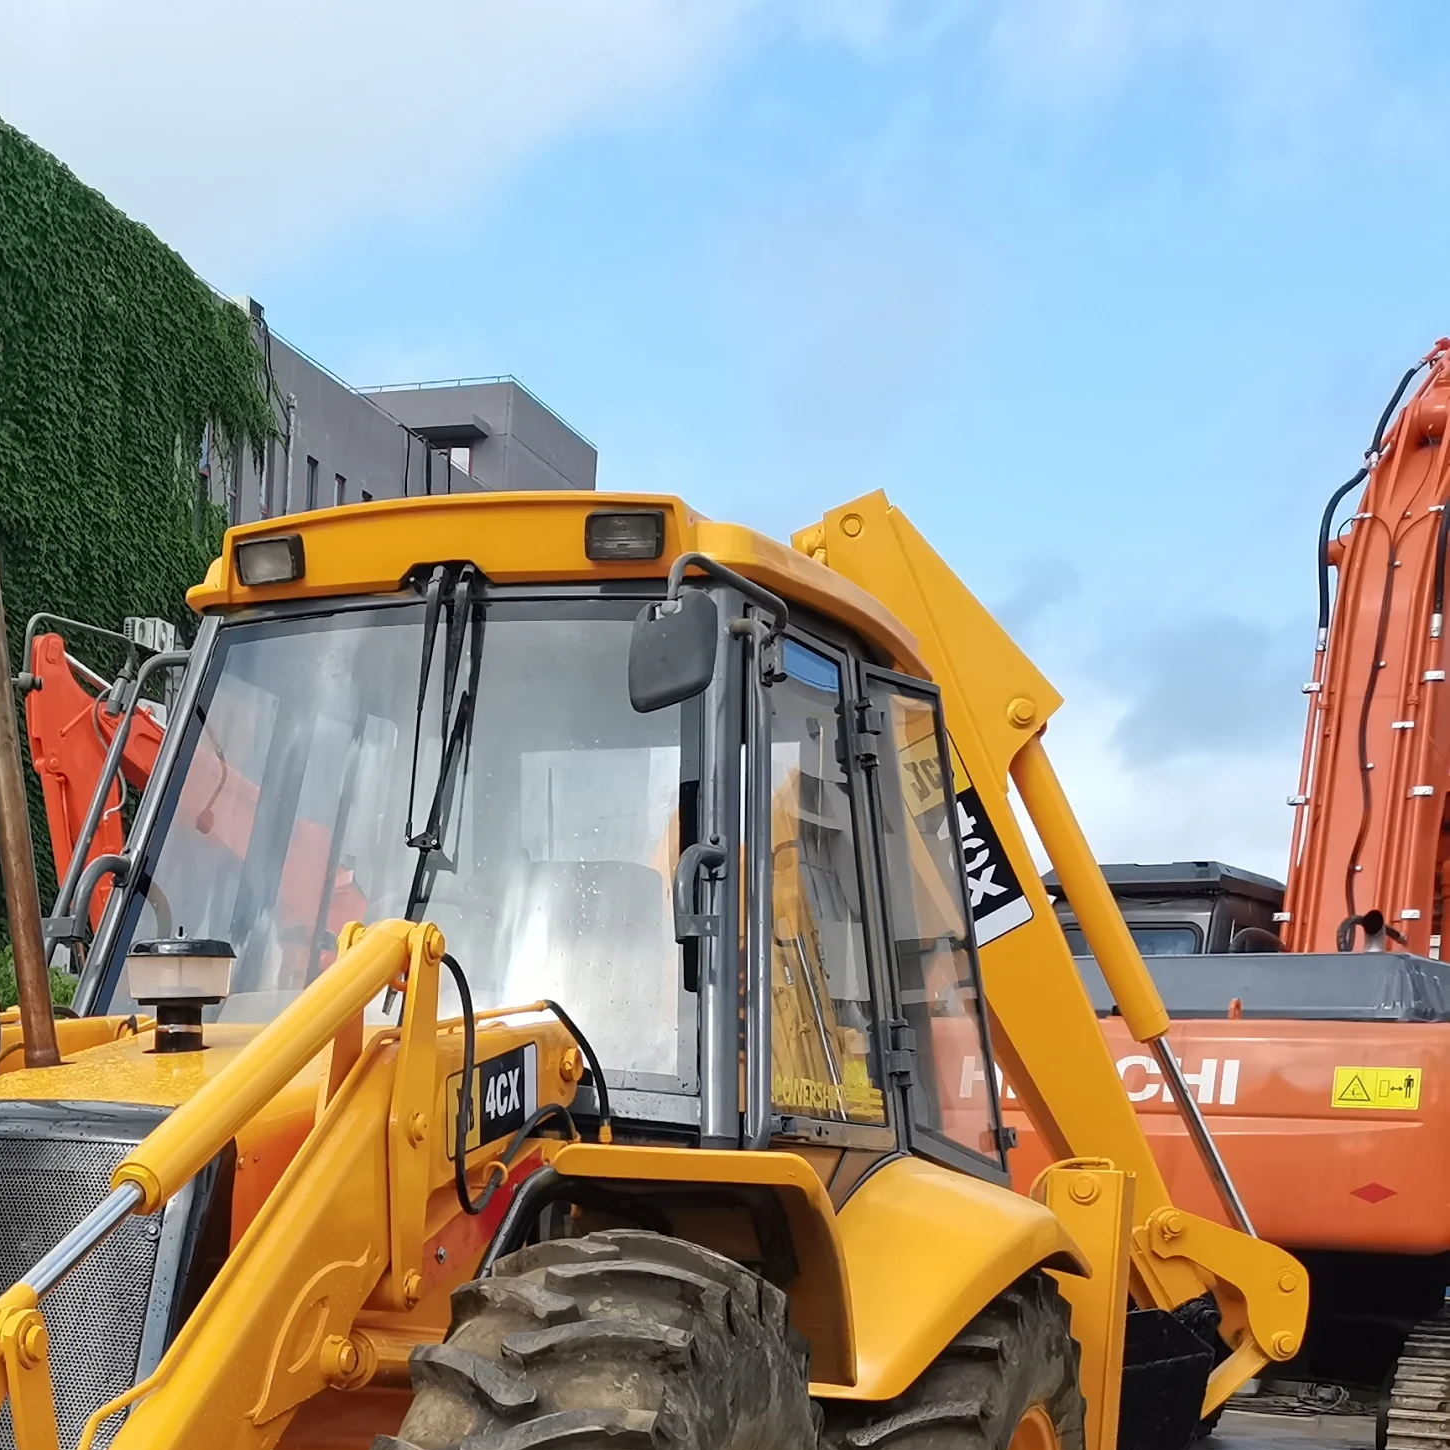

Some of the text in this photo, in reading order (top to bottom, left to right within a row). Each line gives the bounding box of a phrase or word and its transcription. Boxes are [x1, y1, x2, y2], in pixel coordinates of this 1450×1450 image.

[903, 755, 1009, 908] JC 4CX
[485, 1067, 520, 1120] 4CX
[959, 1055, 1240, 1105] HCHI
